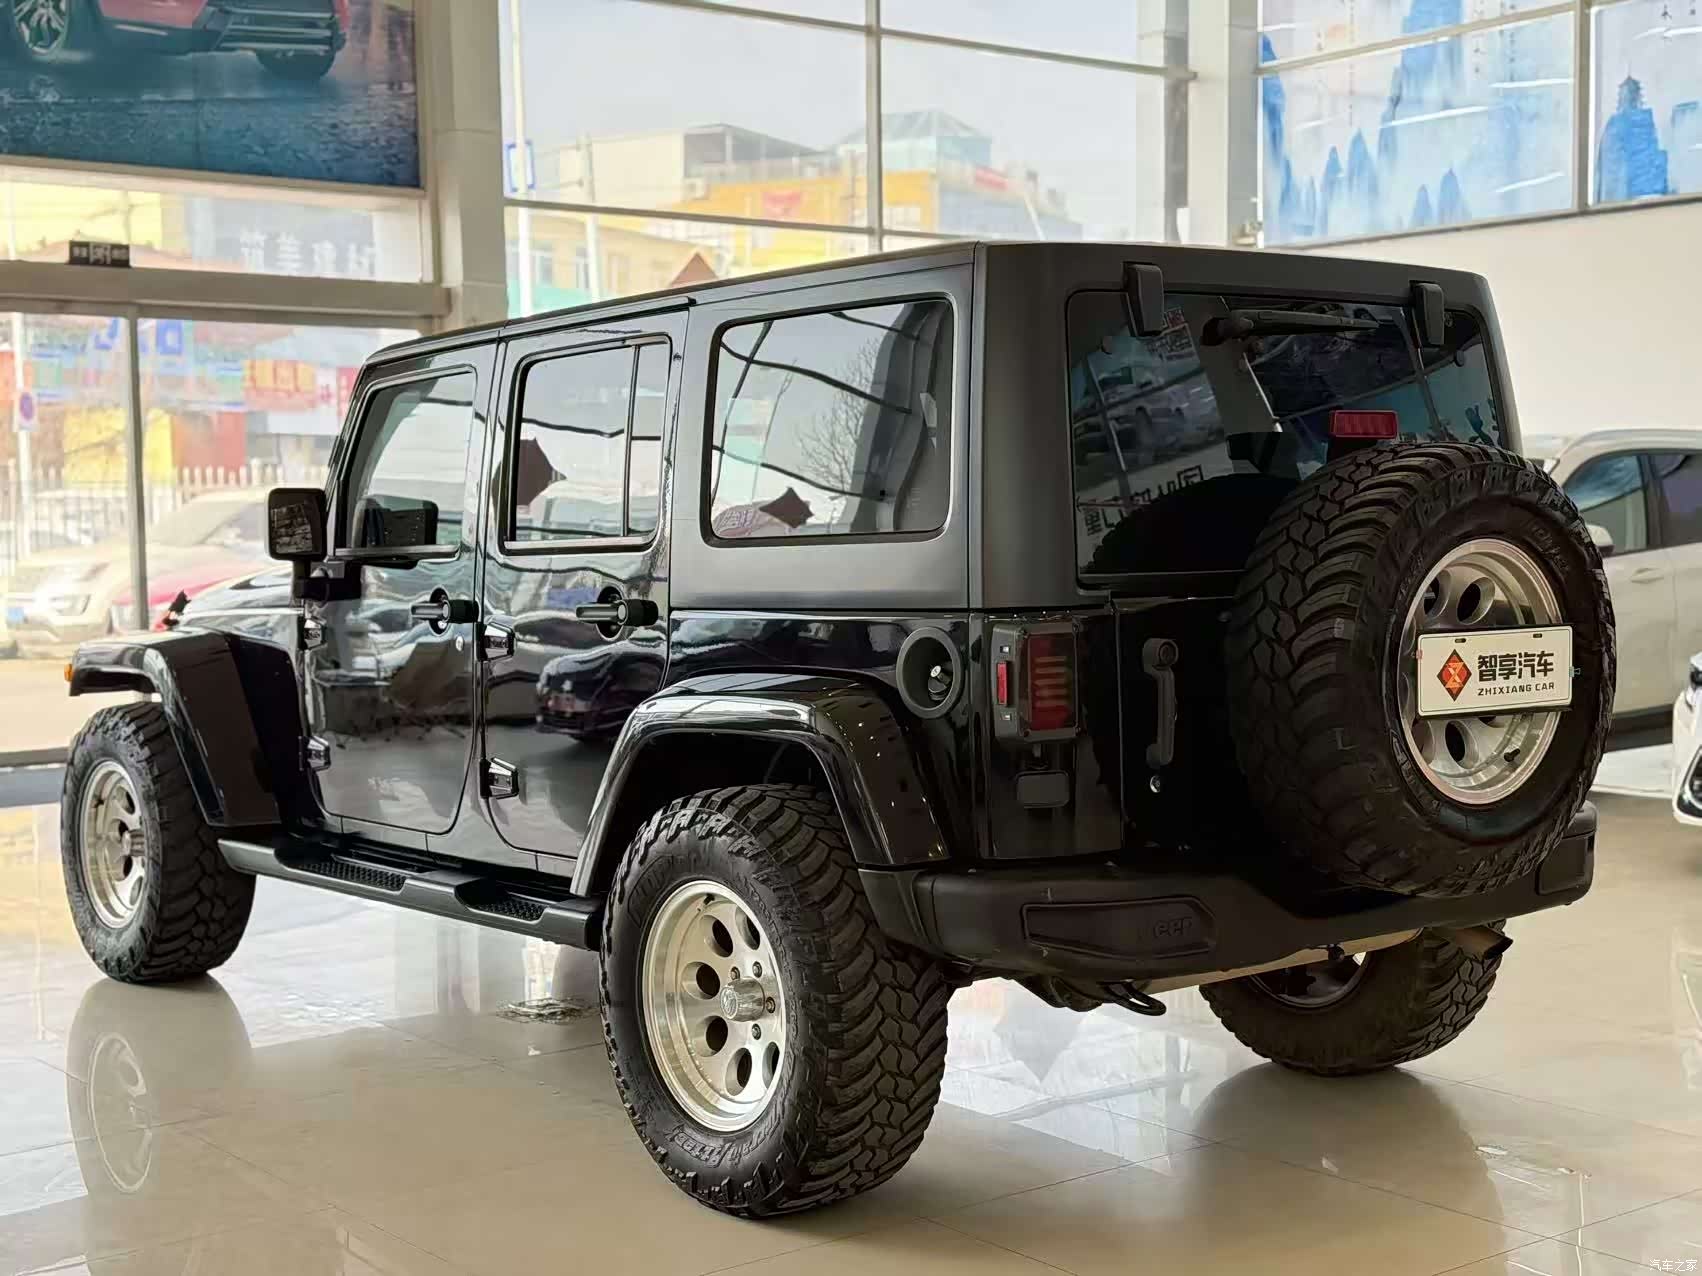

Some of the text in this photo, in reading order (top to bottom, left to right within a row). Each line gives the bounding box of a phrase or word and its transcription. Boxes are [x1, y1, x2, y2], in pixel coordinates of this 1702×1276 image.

[1477, 650, 1555, 682] 智享汽车
[1477, 682, 1555, 696] ZHIXIANG CAR
[1141, 916, 1193, 939] eep
